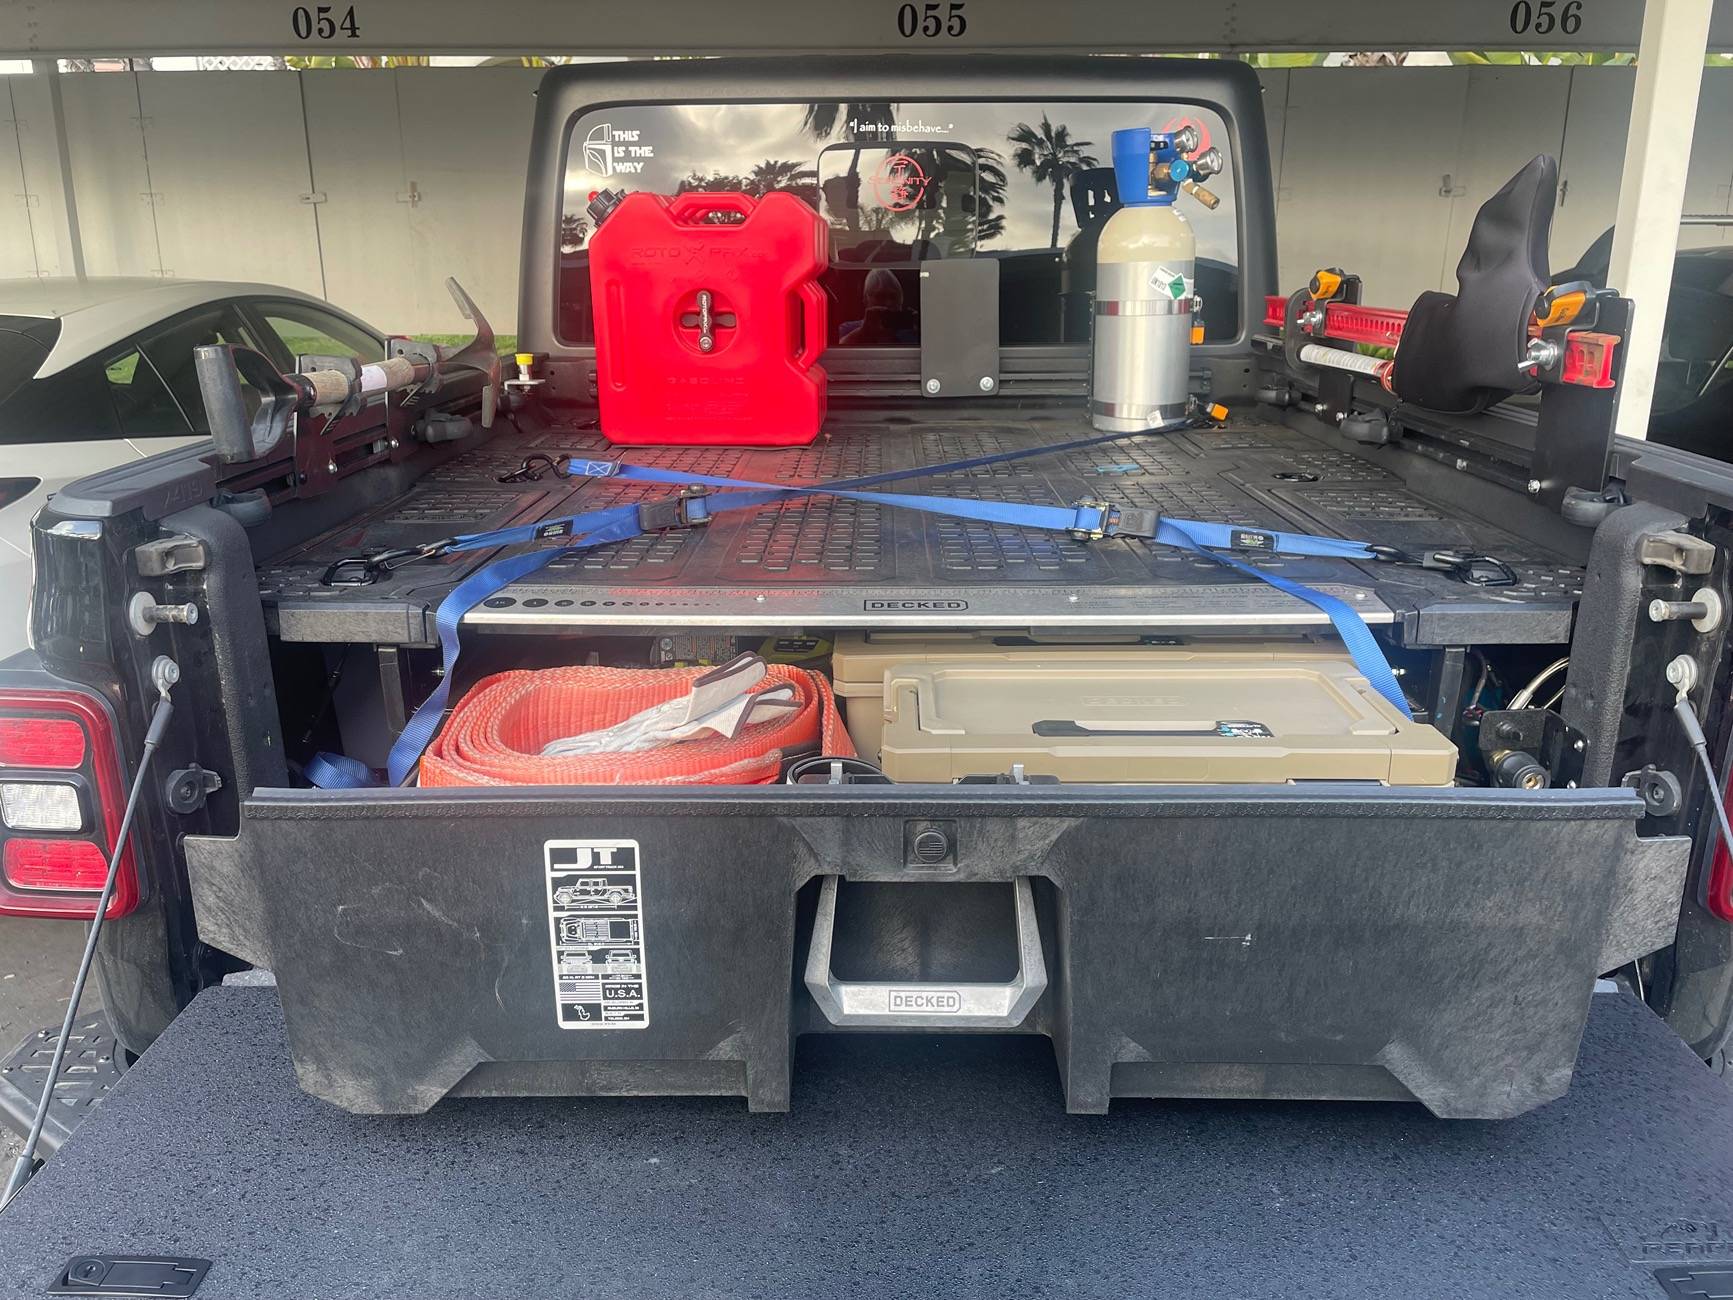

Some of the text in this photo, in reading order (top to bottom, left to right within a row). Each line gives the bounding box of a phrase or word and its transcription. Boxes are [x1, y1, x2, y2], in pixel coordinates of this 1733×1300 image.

[292, 6, 360, 39] 054
[898, 3, 967, 38] 055
[1510, 0, 1582, 35] 056
[860, 121, 876, 132] aim
[877, 122, 890, 132] to
[612, 130, 640, 142] THIS
[613, 146, 654, 158] IS THE
[612, 162, 644, 173] WAY
[553, 848, 618, 869] JT
[606, 989, 641, 998] U.S.A.
[893, 995, 956, 1008] DECKED
